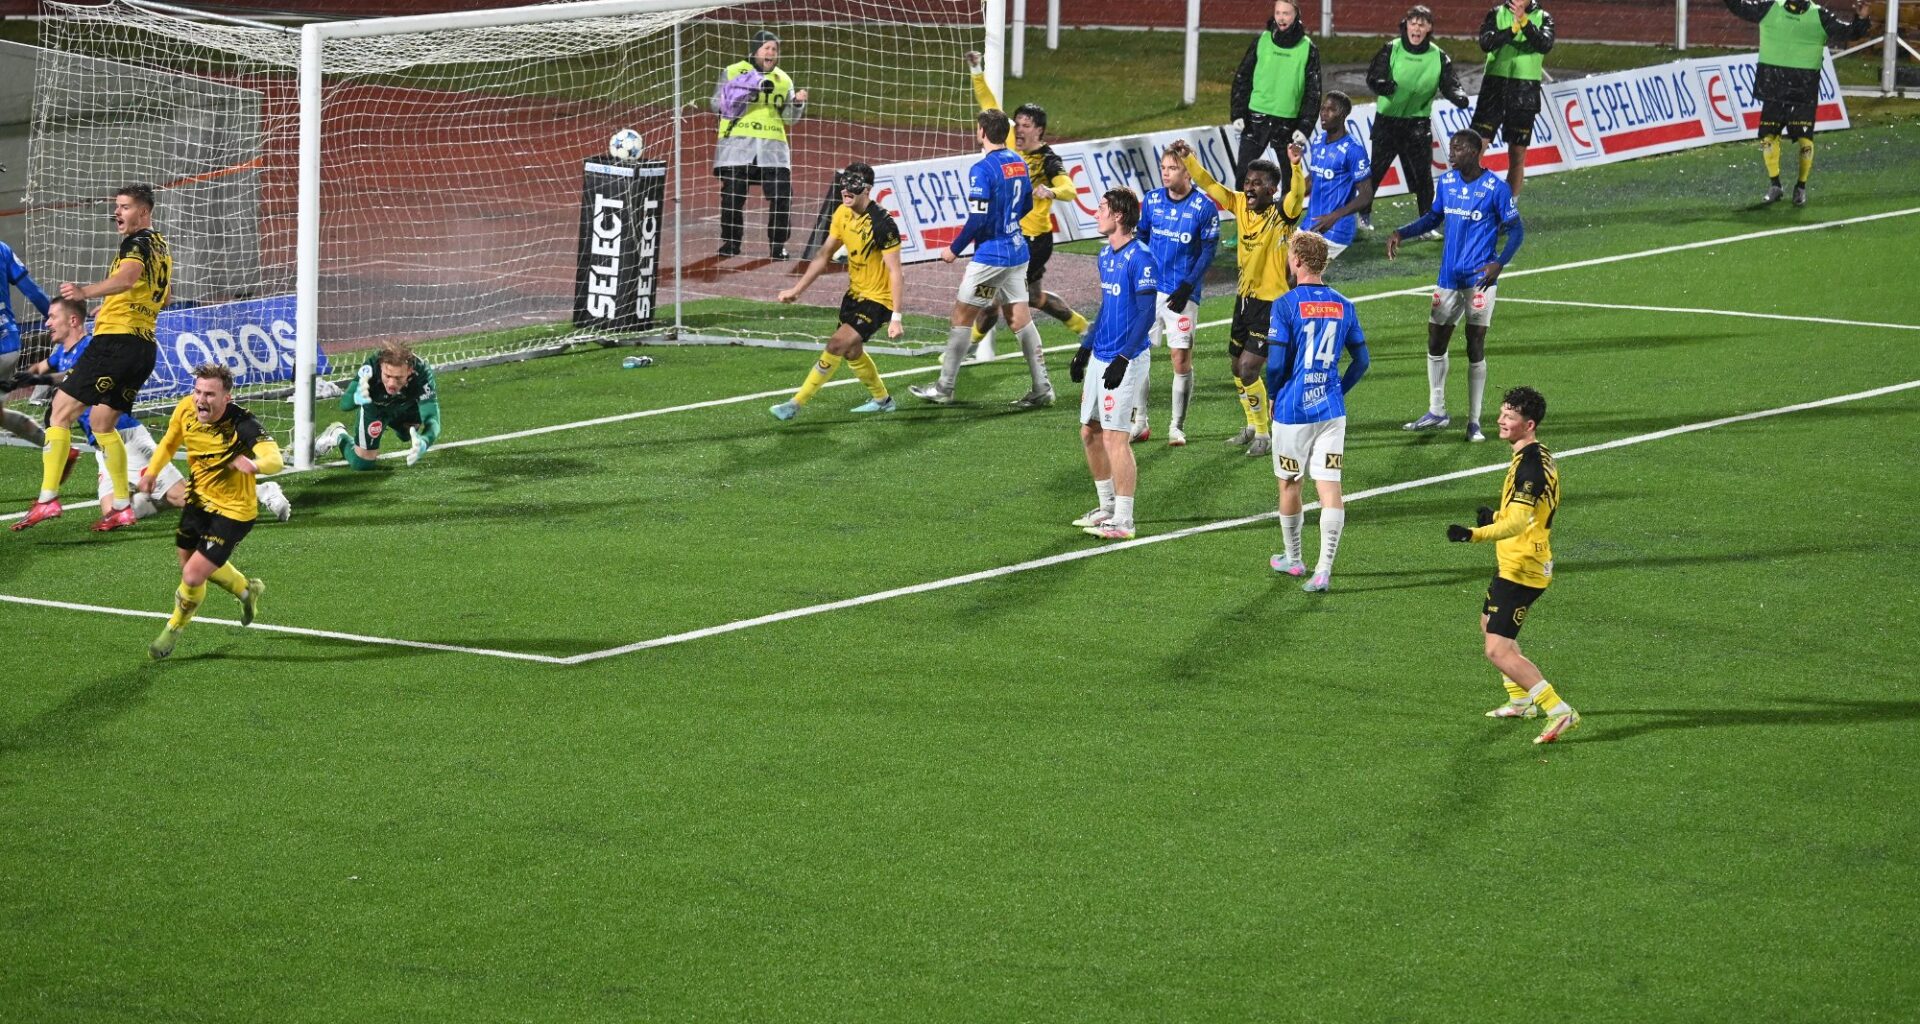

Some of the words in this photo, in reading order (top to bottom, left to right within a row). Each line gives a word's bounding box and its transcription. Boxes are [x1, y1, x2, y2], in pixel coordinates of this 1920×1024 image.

[1586, 75, 1669, 132] ESPELAND
[1672, 70, 1696, 118] AS
[905, 169, 970, 224] ESPEL
[1094, 143, 1167, 195] ESPEL
[587, 193, 624, 319] SELECT
[636, 197, 659, 319] SELECT
[176, 319, 296, 379] OBOS
[1303, 321, 1337, 369] 14
[1280, 456, 1298, 471] XL
